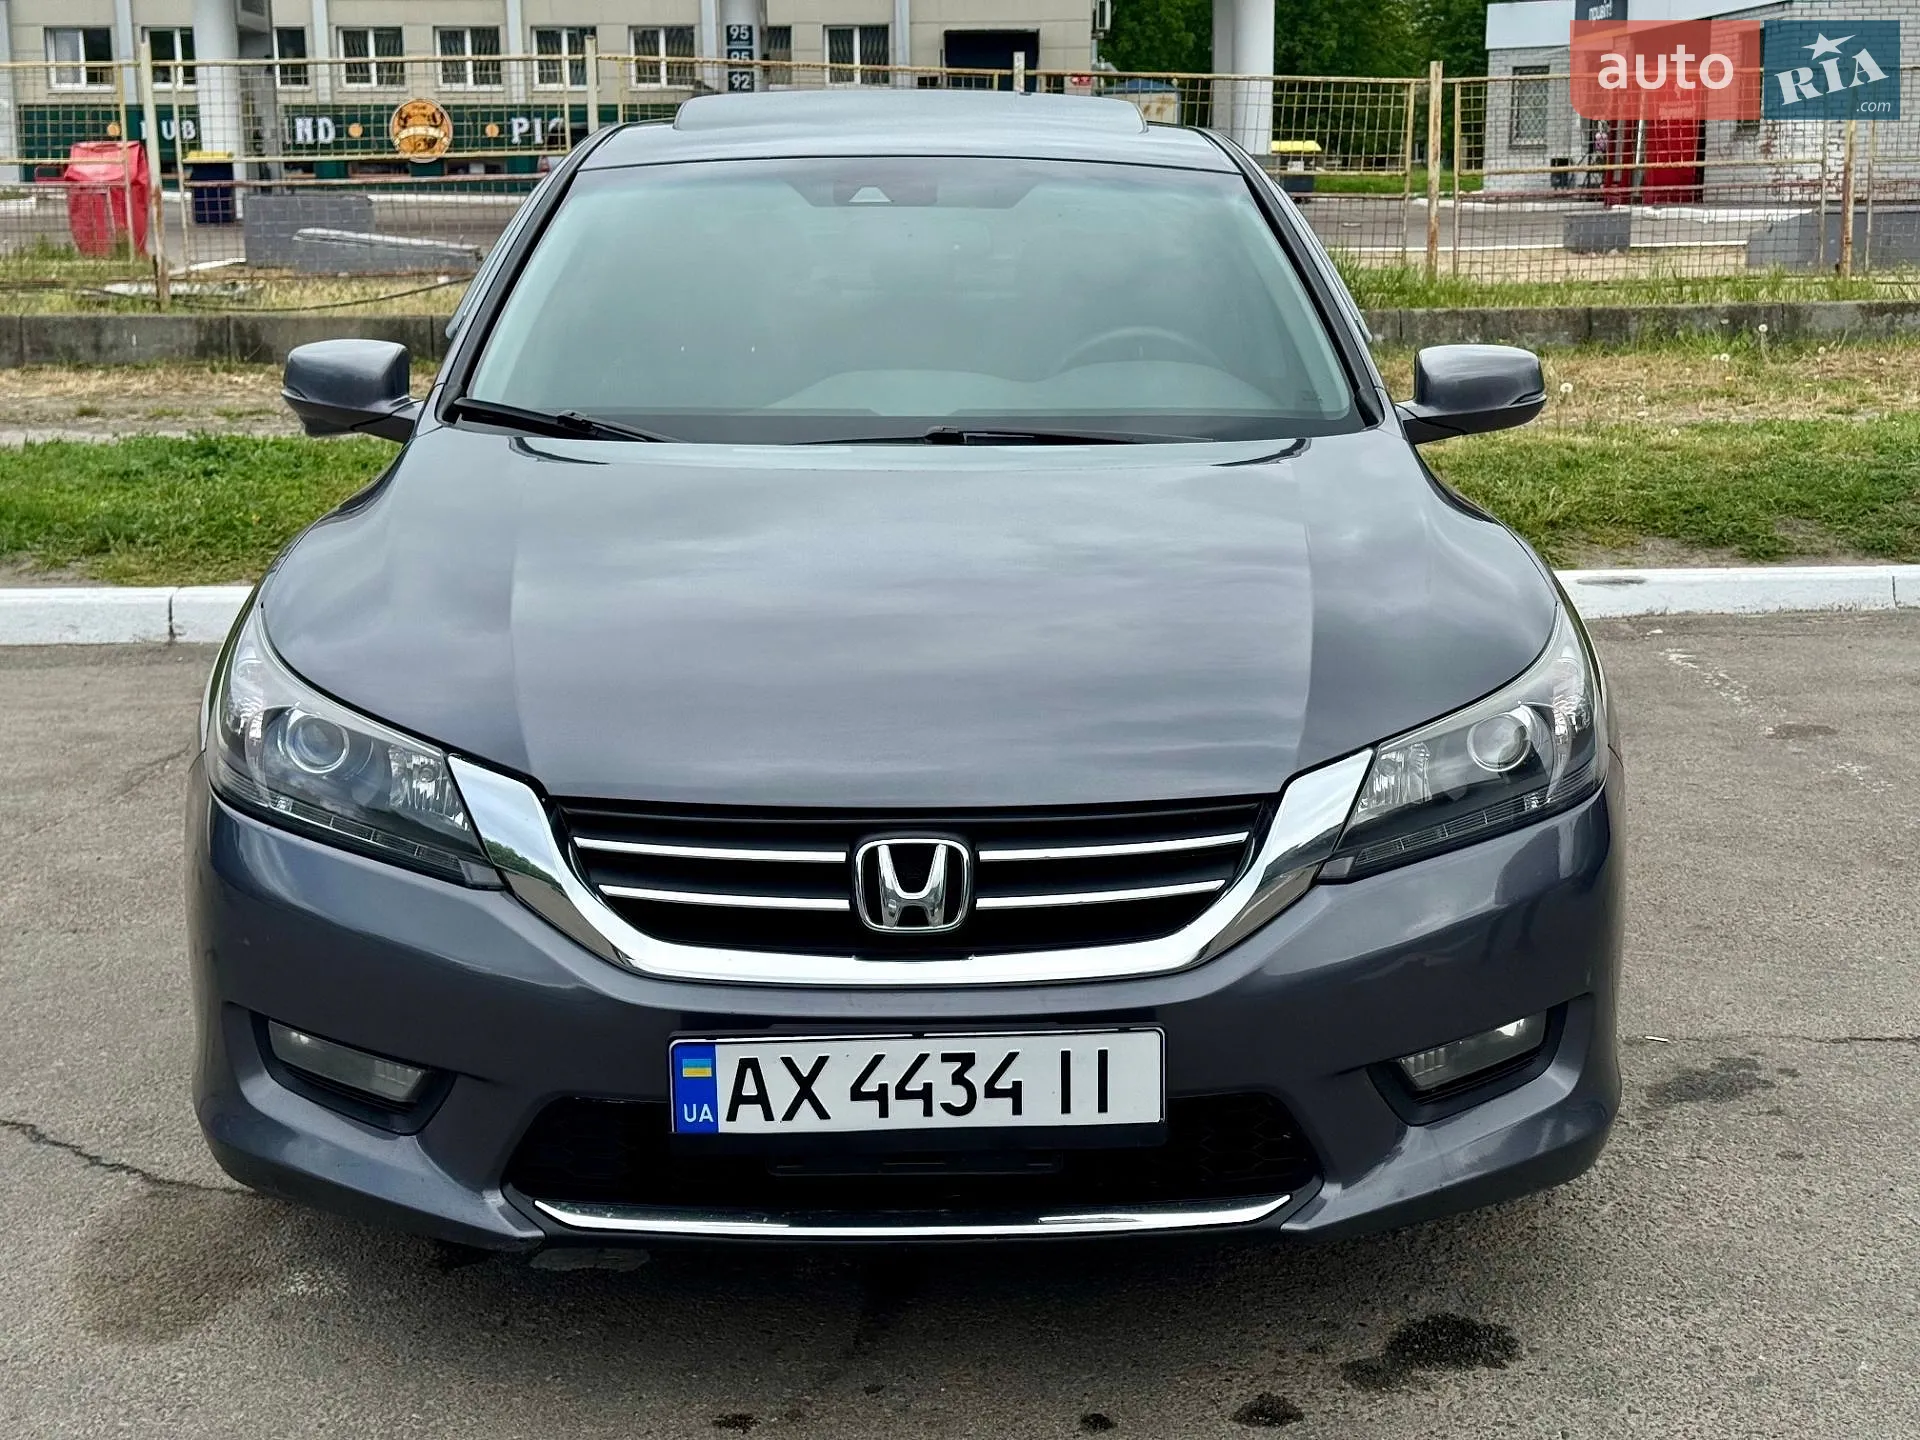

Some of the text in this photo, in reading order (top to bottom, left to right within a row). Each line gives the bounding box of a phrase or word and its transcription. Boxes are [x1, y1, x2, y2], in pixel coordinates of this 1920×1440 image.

[729, 25, 750, 40] 95
[731, 73, 752, 89] 92
[726, 1055, 832, 1122] AX
[850, 1051, 1024, 1119] 4434
[683, 1103, 714, 1124] UA
